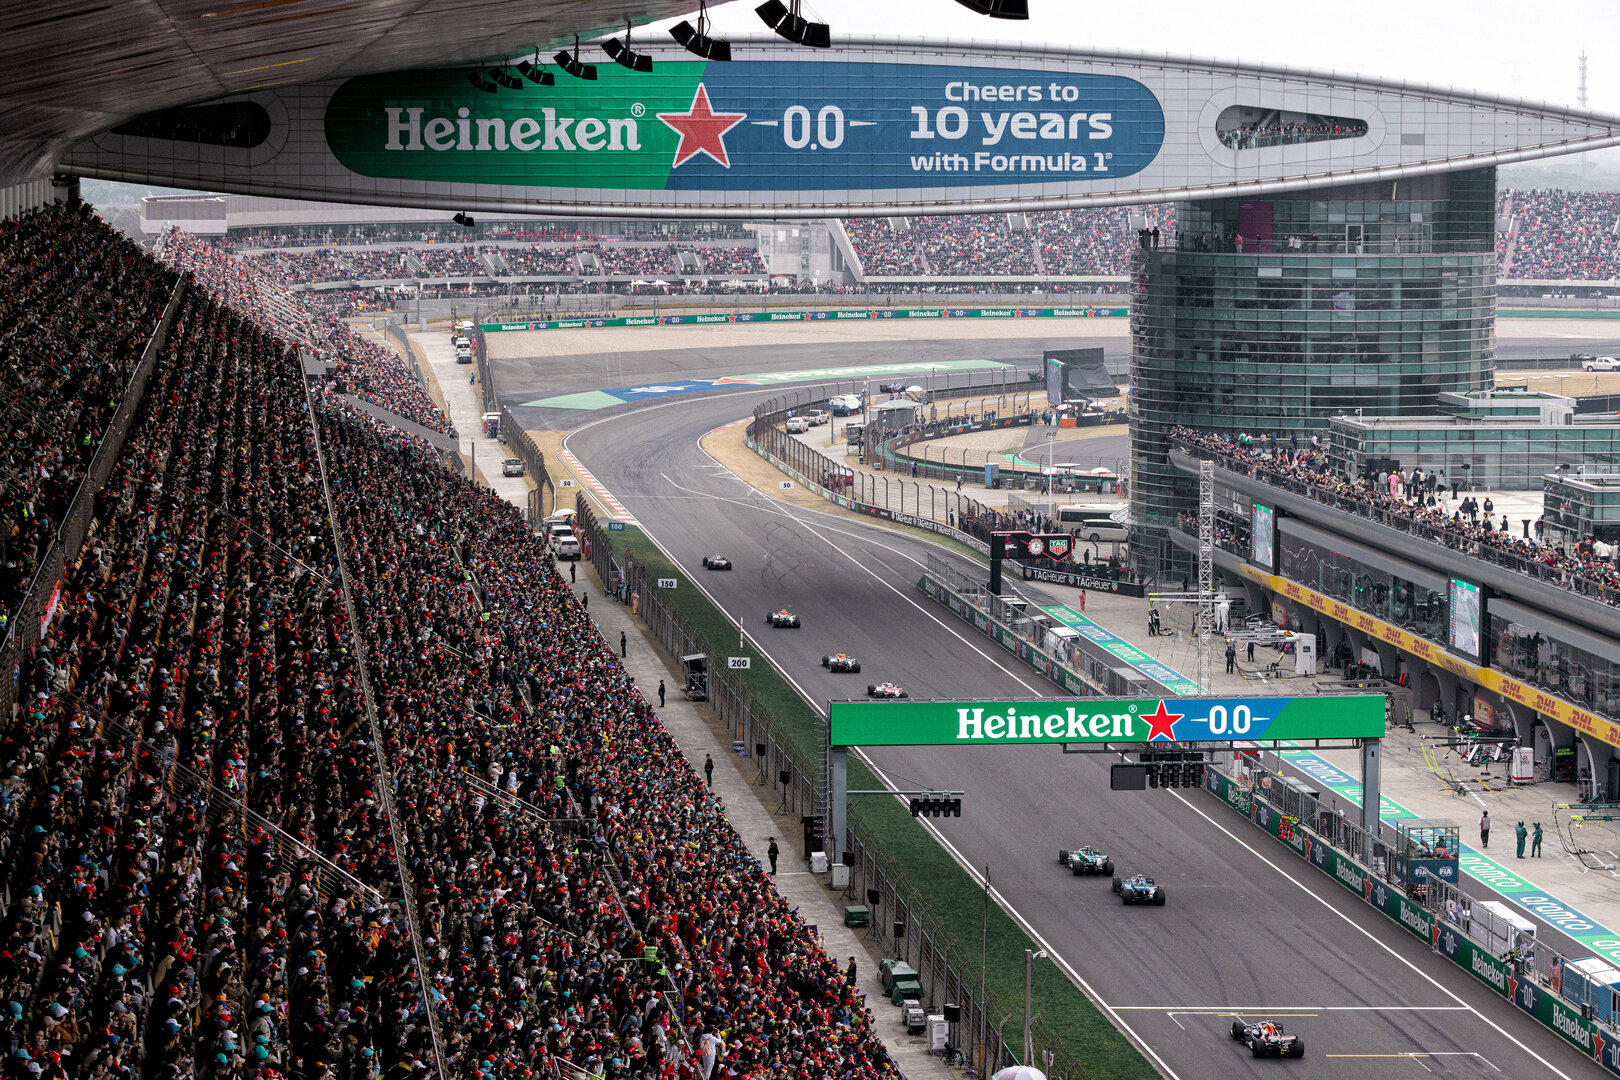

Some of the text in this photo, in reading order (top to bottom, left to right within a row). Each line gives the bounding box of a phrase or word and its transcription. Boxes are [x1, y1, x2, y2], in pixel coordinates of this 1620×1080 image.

[945, 82, 1080, 102] Cheers to
[783, 105, 844, 150] 0.0
[910, 106, 1113, 146] 10 years
[910, 152, 970, 172] with
[974, 152, 1086, 172] Formula
[1209, 705, 1251, 734] 0.0
[1336, 858, 1363, 892] Heineken
[1400, 900, 1430, 938] Heineken
[1520, 896, 1594, 930] aramco
[1472, 949, 1505, 990] Heineken
[1553, 1003, 1590, 1048] Heineken
